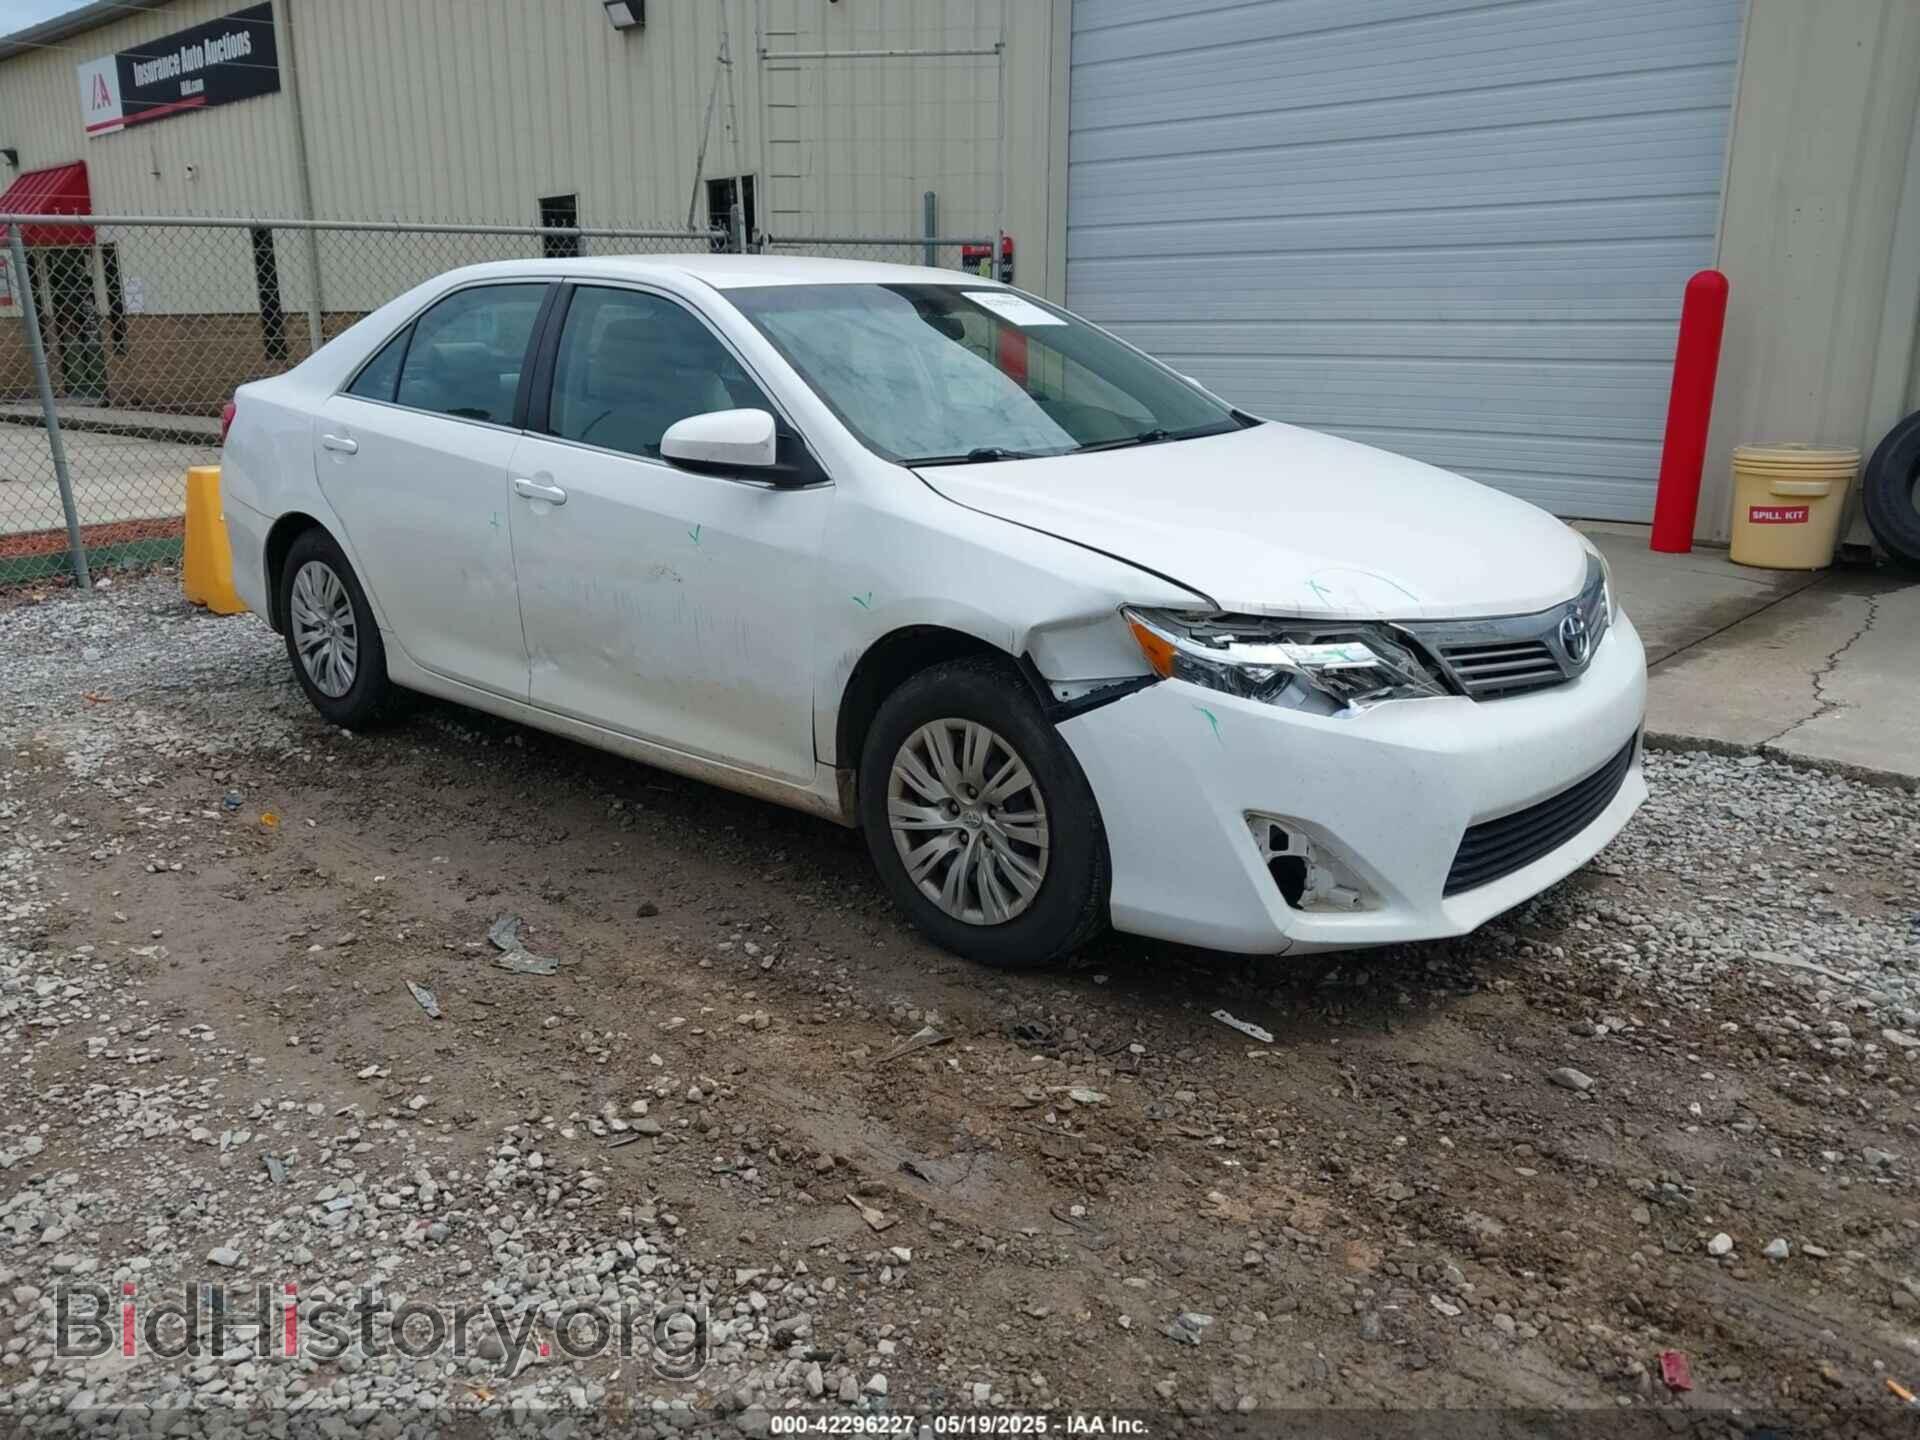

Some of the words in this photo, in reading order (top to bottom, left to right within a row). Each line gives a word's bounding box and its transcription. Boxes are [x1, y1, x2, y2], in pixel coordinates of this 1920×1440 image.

[132, 53, 180, 87] Insurance
[180, 44, 204, 73] Auto
[204, 30, 252, 66] Auctions
[1752, 510, 1782, 521] SPILL
[1785, 510, 1805, 521] KIT
